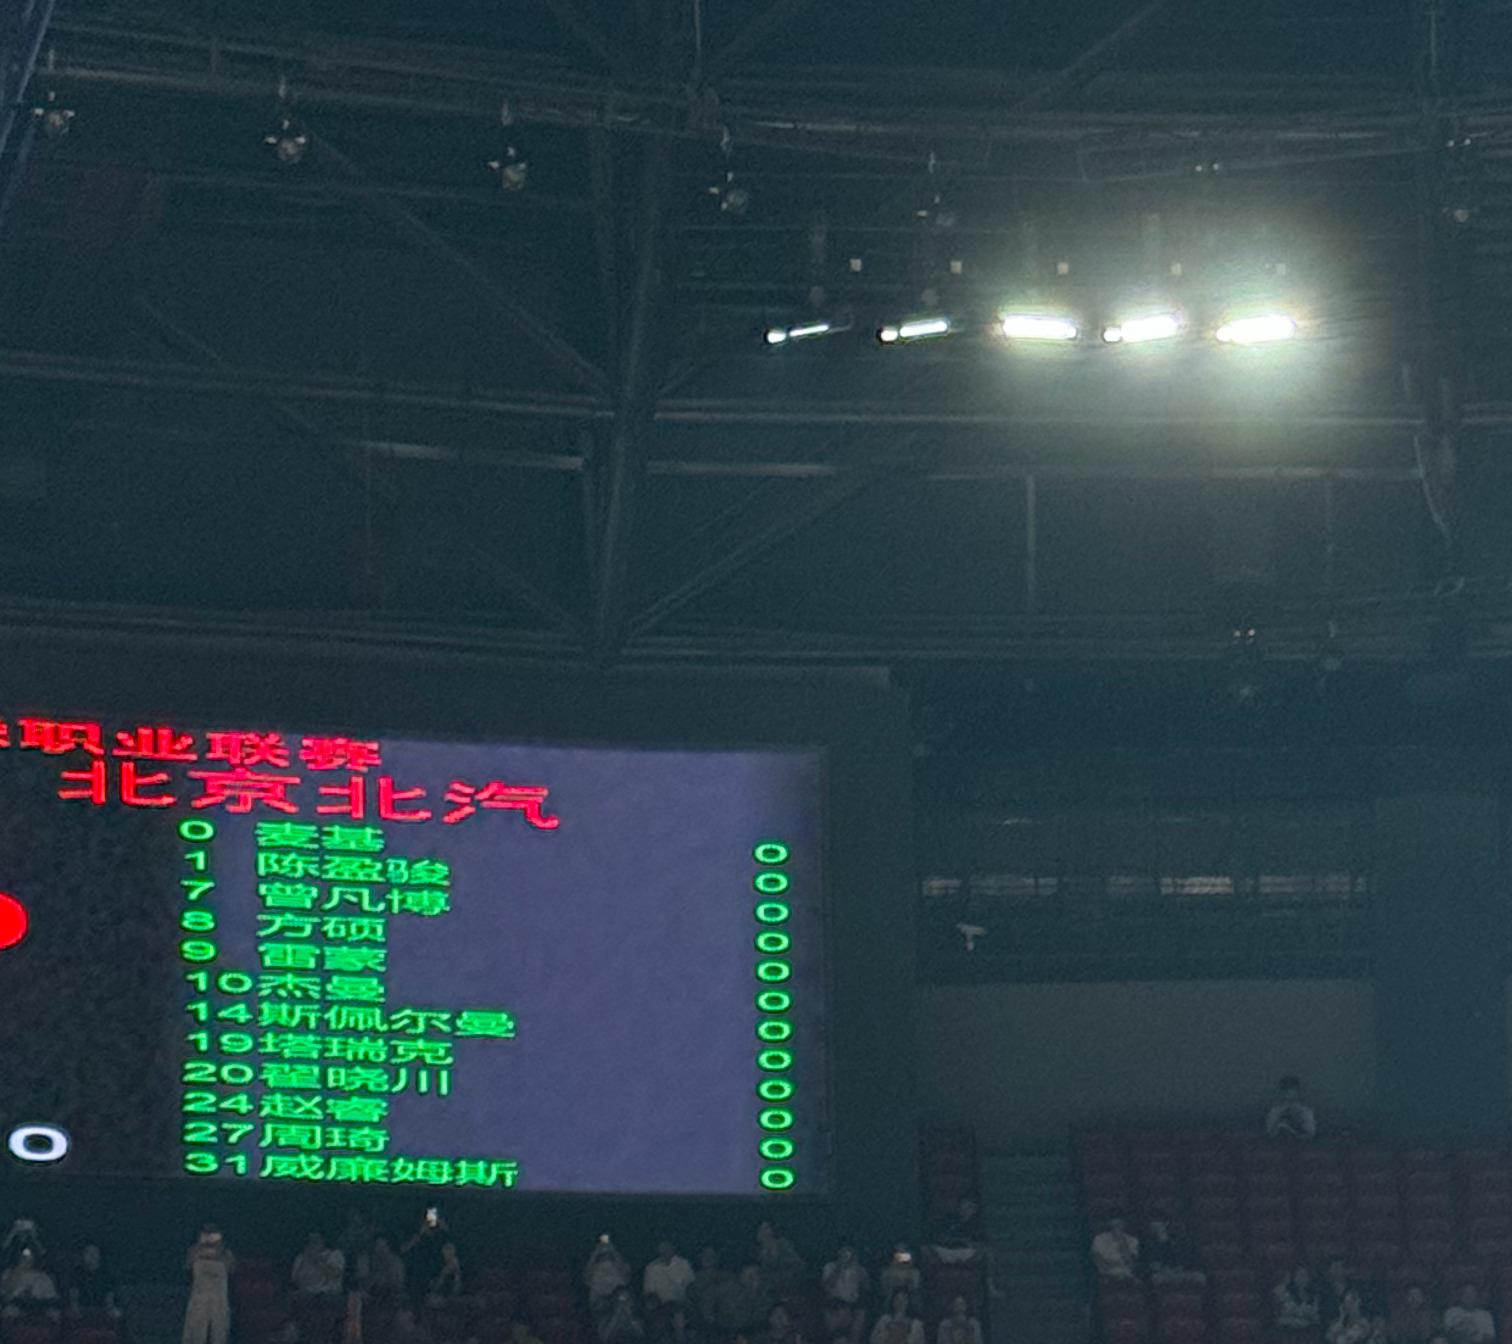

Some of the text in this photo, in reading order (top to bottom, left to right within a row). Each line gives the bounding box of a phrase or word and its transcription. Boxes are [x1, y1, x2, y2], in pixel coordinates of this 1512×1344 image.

[0, 719, 382, 772] 职业联赛
[58, 761, 561, 829] 北京北汽
[180, 820, 214, 841] 0
[755, 844, 787, 862] 0
[185, 851, 206, 871] 1
[755, 873, 787, 892] 0
[182, 880, 215, 900] 7
[757, 903, 788, 922] 0
[181, 911, 788, 951] 8 方硕 0
[181, 941, 216, 961] 9
[758, 962, 789, 980] 0
[187, 972, 254, 993] 10
[758, 991, 790, 1010] 0
[186, 1002, 252, 1022] 14
[759, 1021, 790, 1039] 0
[187, 1032, 254, 1053] 19
[759, 1050, 791, 1069] 0
[183, 1062, 254, 1083] 20
[760, 1080, 792, 1099] 0
[183, 1092, 253, 1113] 24
[760, 1109, 792, 1129] 0
[10, 1126, 69, 1161] 0
[184, 1122, 254, 1143] 27
[761, 1139, 792, 1158] 0
[185, 1152, 249, 1174] 31
[762, 1169, 793, 1188] 0
